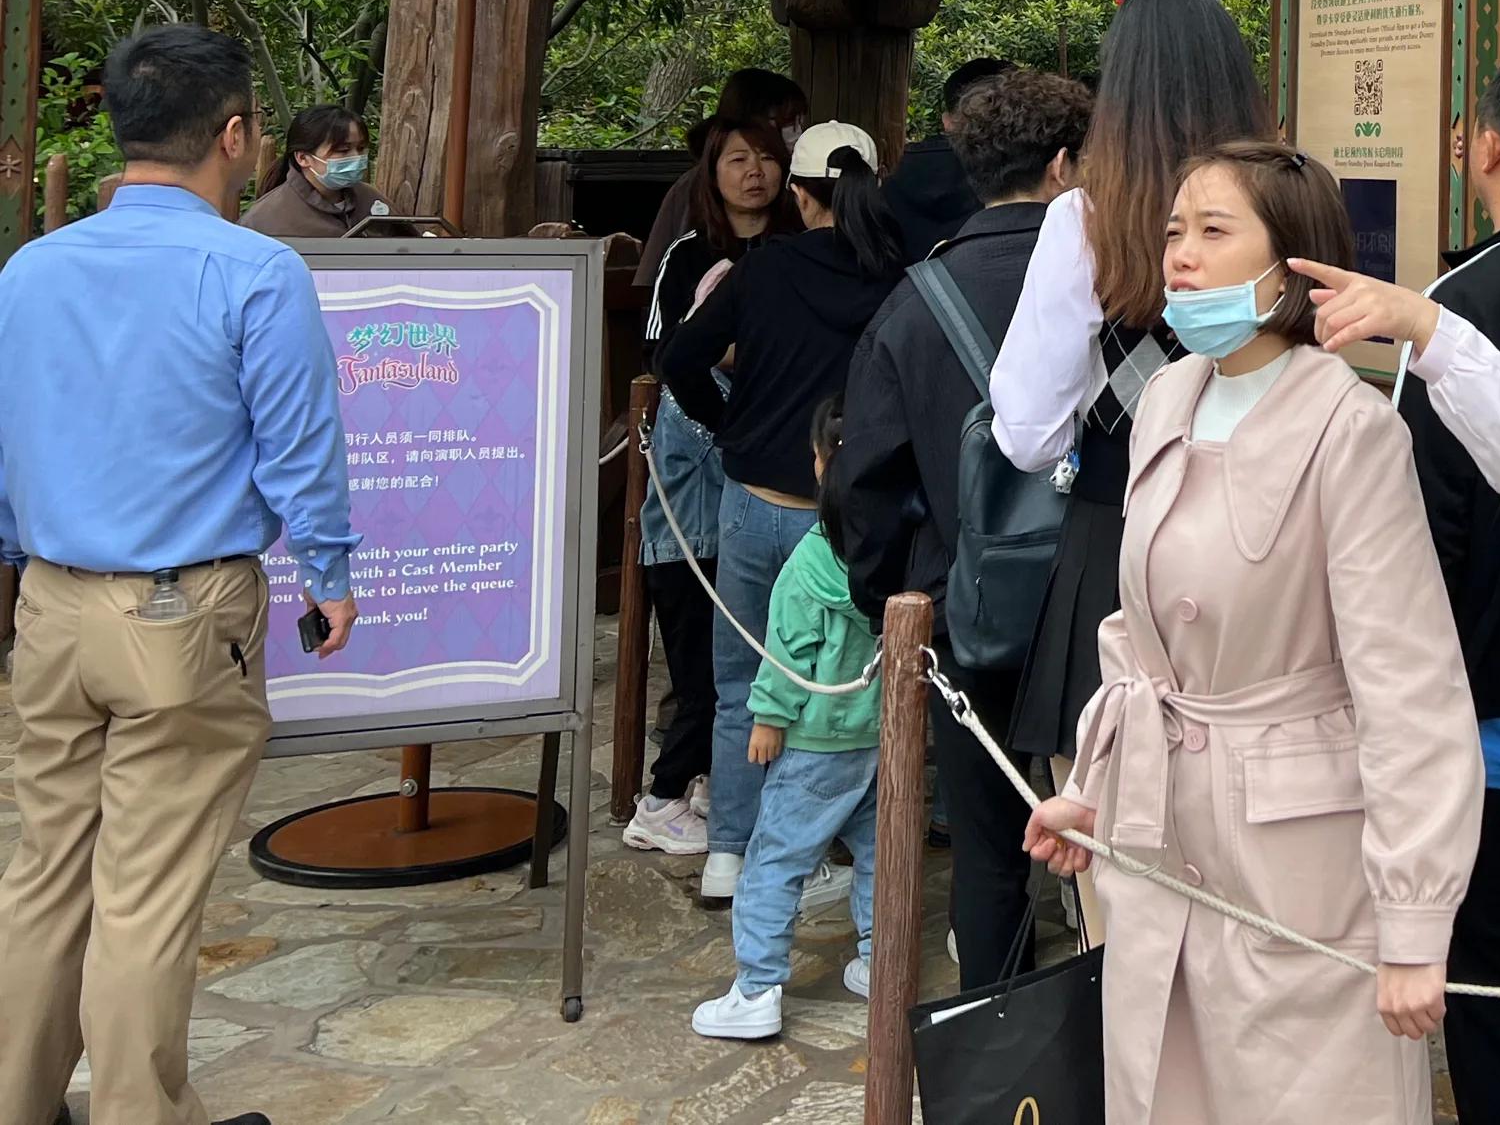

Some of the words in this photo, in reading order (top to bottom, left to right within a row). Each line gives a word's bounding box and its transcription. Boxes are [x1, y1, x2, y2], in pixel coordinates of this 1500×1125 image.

[347, 322, 460, 356] 梦幻世界
[337, 352, 459, 395] Fantasyland
[357, 546, 390, 560] with
[394, 547, 429, 562] your
[433, 542, 476, 556] entire
[480, 541, 518, 557] party
[269, 571, 297, 585] and
[350, 565, 383, 579] with
[388, 568, 397, 577] a
[402, 563, 434, 576] Cast
[440, 558, 502, 574] Member
[381, 585, 396, 597] to
[401, 582, 439, 595] leave
[444, 579, 467, 592] the
[393, 607, 428, 626] you!
